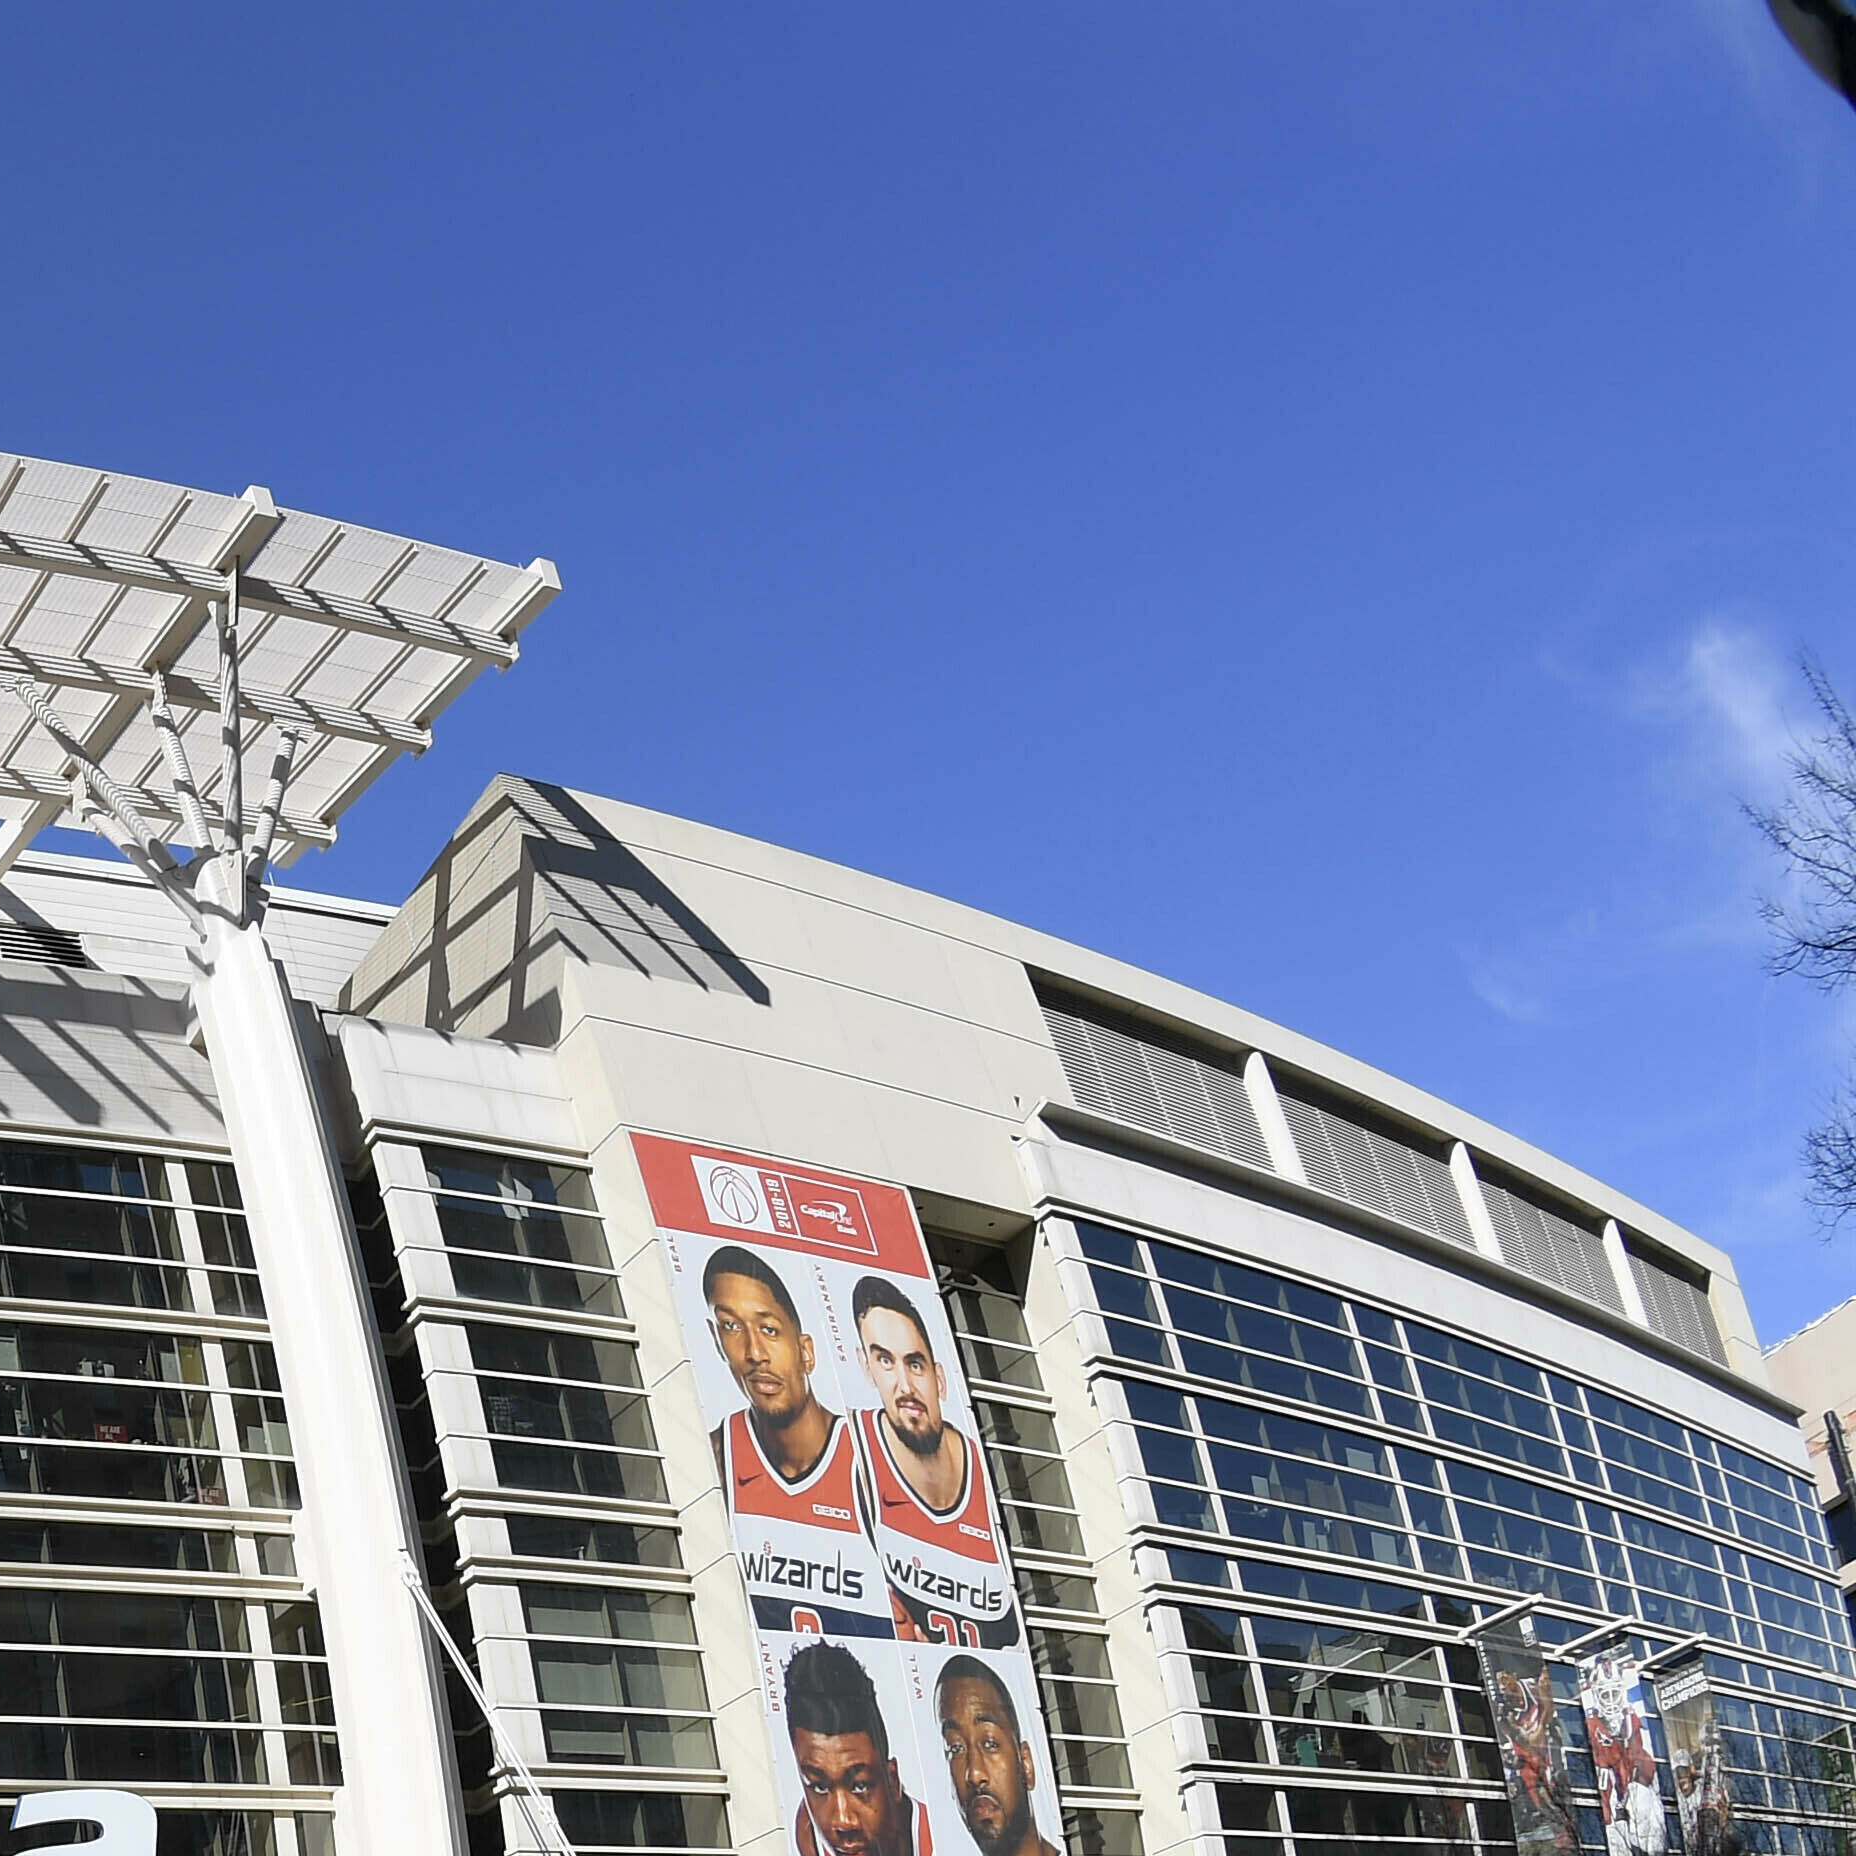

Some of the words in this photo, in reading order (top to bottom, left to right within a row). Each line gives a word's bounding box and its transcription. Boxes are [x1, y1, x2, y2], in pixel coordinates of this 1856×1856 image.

[765, 1177, 793, 1229] 2018-19
[666, 1234, 682, 1273] BEAL
[812, 1263, 847, 1362] SATORANSKY
[743, 1541, 865, 1600] wizards
[887, 1555, 1003, 1612] wizards
[760, 1640, 781, 1712] BRYANT
[910, 1652, 923, 1700] WALL
